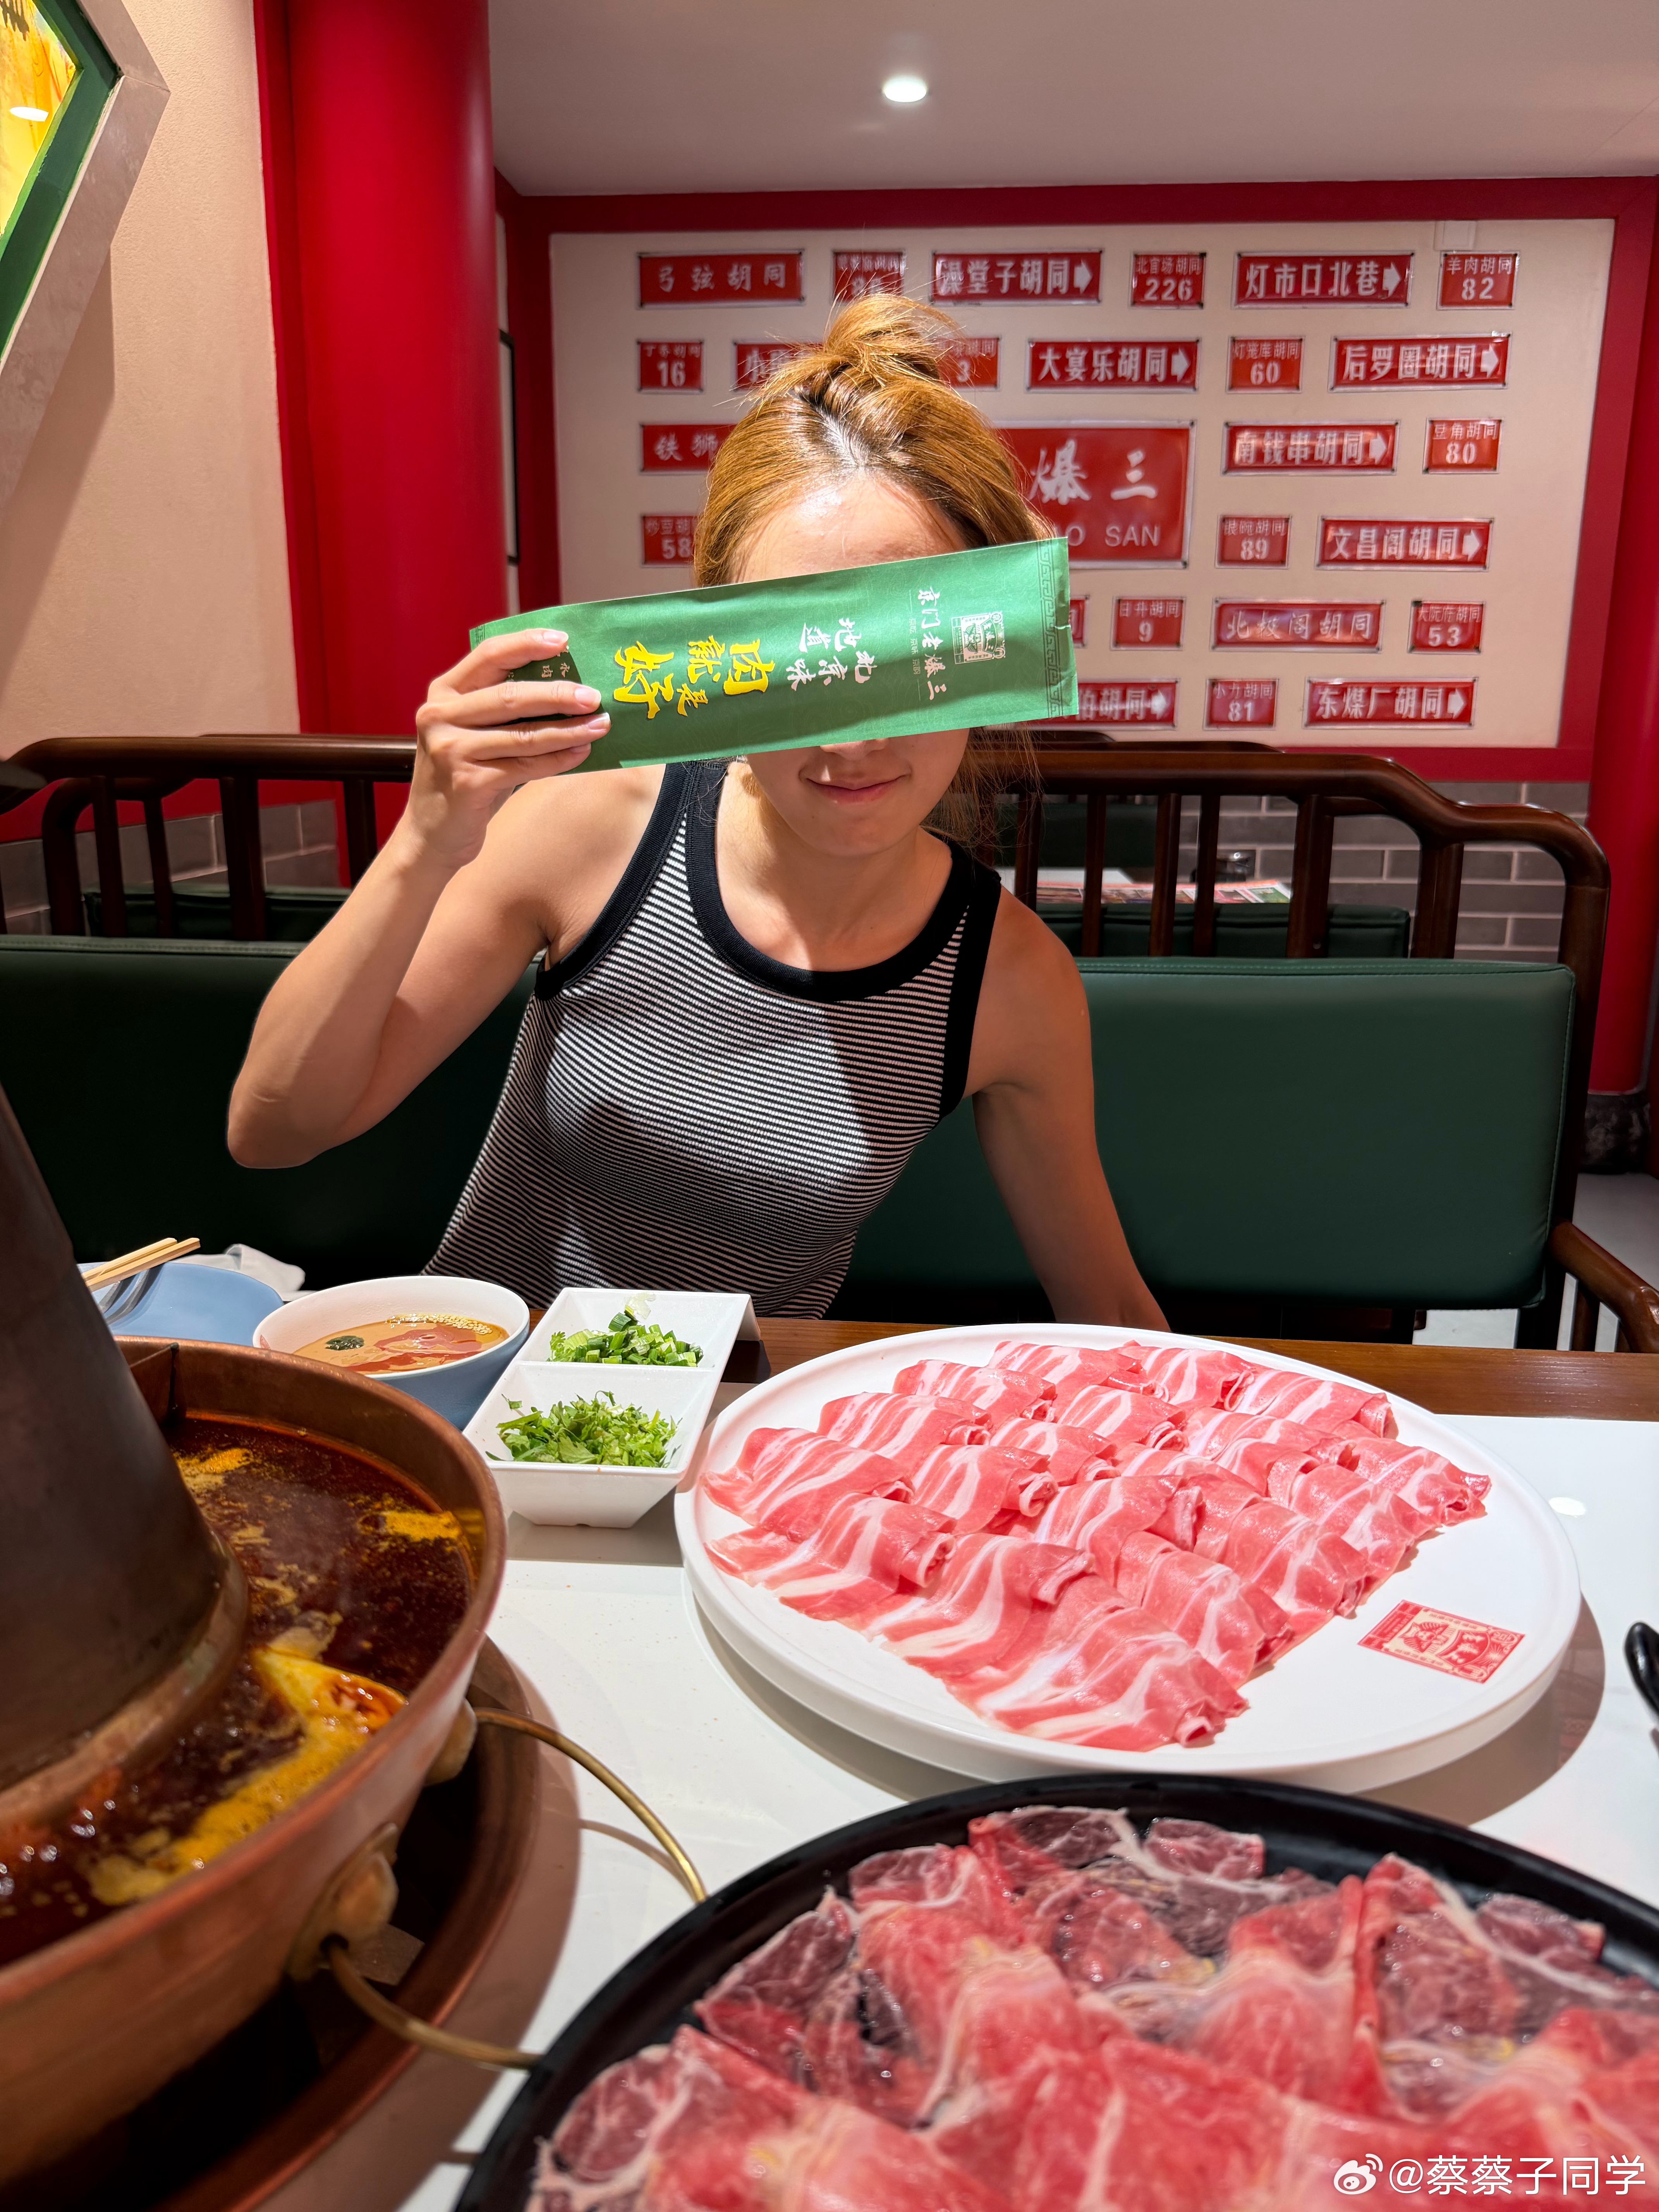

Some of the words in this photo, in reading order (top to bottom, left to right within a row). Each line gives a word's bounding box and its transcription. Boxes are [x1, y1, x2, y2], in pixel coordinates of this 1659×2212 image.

[658, 262, 786, 292] 弓弦胡同
[1446, 256, 1513, 275] 羊肉胡同
[1144, 278, 1193, 301] 226
[1245, 260, 1379, 299] 灯市口北巷
[1461, 277, 1494, 300] 82
[956, 360, 970, 382] 3
[1038, 347, 1170, 383] 大宴乐胡同
[1250, 361, 1281, 385] 60
[1343, 343, 1475, 381] 后罗圈胡同
[657, 361, 686, 387] 16
[1433, 422, 1498, 440] 豆角胡同
[1446, 441, 1476, 464] 80
[1105, 525, 1159, 547] SAN
[1330, 527, 1459, 561] 文昌阁胡同
[662, 538, 692, 560] 58
[1240, 539, 1268, 561] 89
[799, 617, 862, 653] 地道
[1139, 621, 1153, 642] 9
[1226, 611, 1372, 640] 北极阁胡同
[1428, 625, 1461, 647] 53
[911, 638, 919, 655] 京味
[786, 651, 878, 691] 北京味
[1228, 700, 1252, 722] 81
[1317, 687, 1442, 719] 东煤厂胡同
